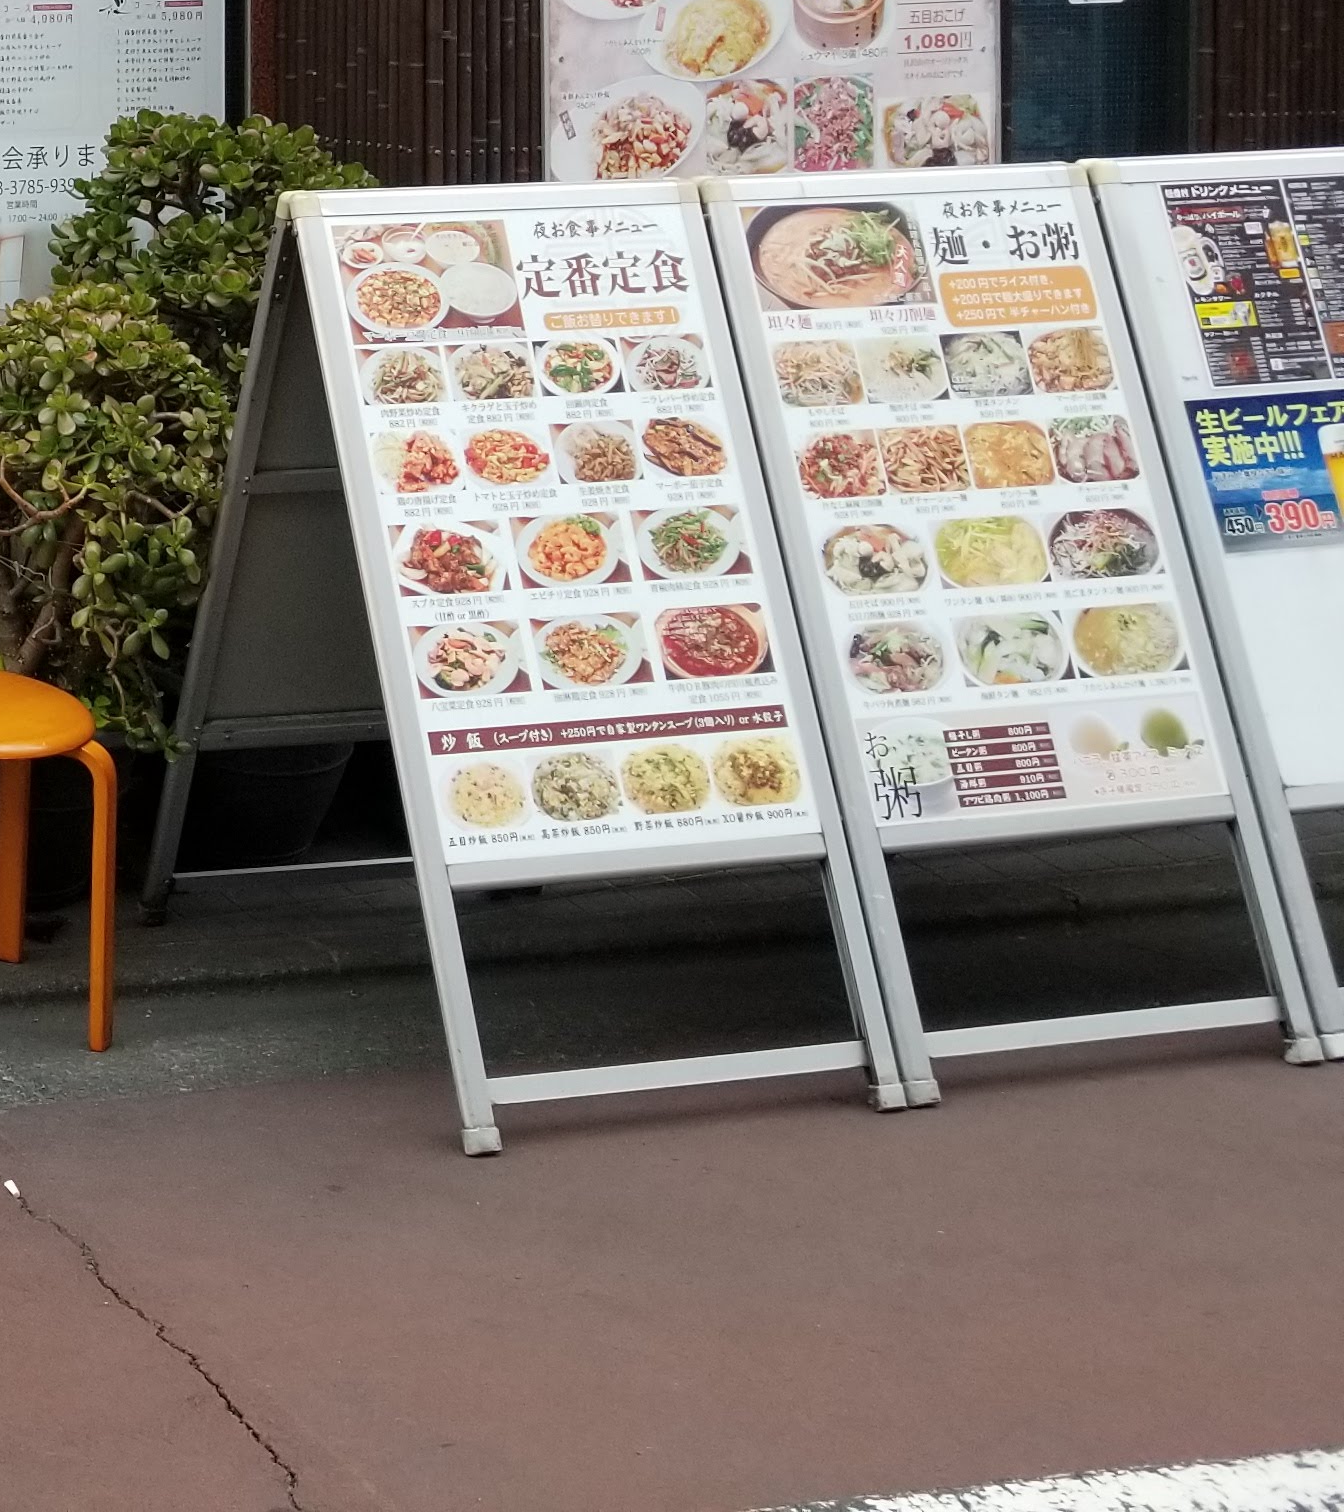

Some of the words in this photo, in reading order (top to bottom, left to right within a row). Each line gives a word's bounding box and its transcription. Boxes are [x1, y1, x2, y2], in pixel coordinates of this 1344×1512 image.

[909, 8, 966, 24] 五目おこげ
[904, 31, 973, 50] 1,080円
[1191, 184, 1274, 198] ドリンクメニュー
[6, 199, 39, 210] 営業時間
[942, 199, 1062, 219] 夜お食事メニュー
[533, 218, 659, 239] 夜お食事メニュー
[515, 248, 690, 300] 定番定食
[441, 732, 484, 752] 炒飯
[752, 710, 784, 724] 水餃子
